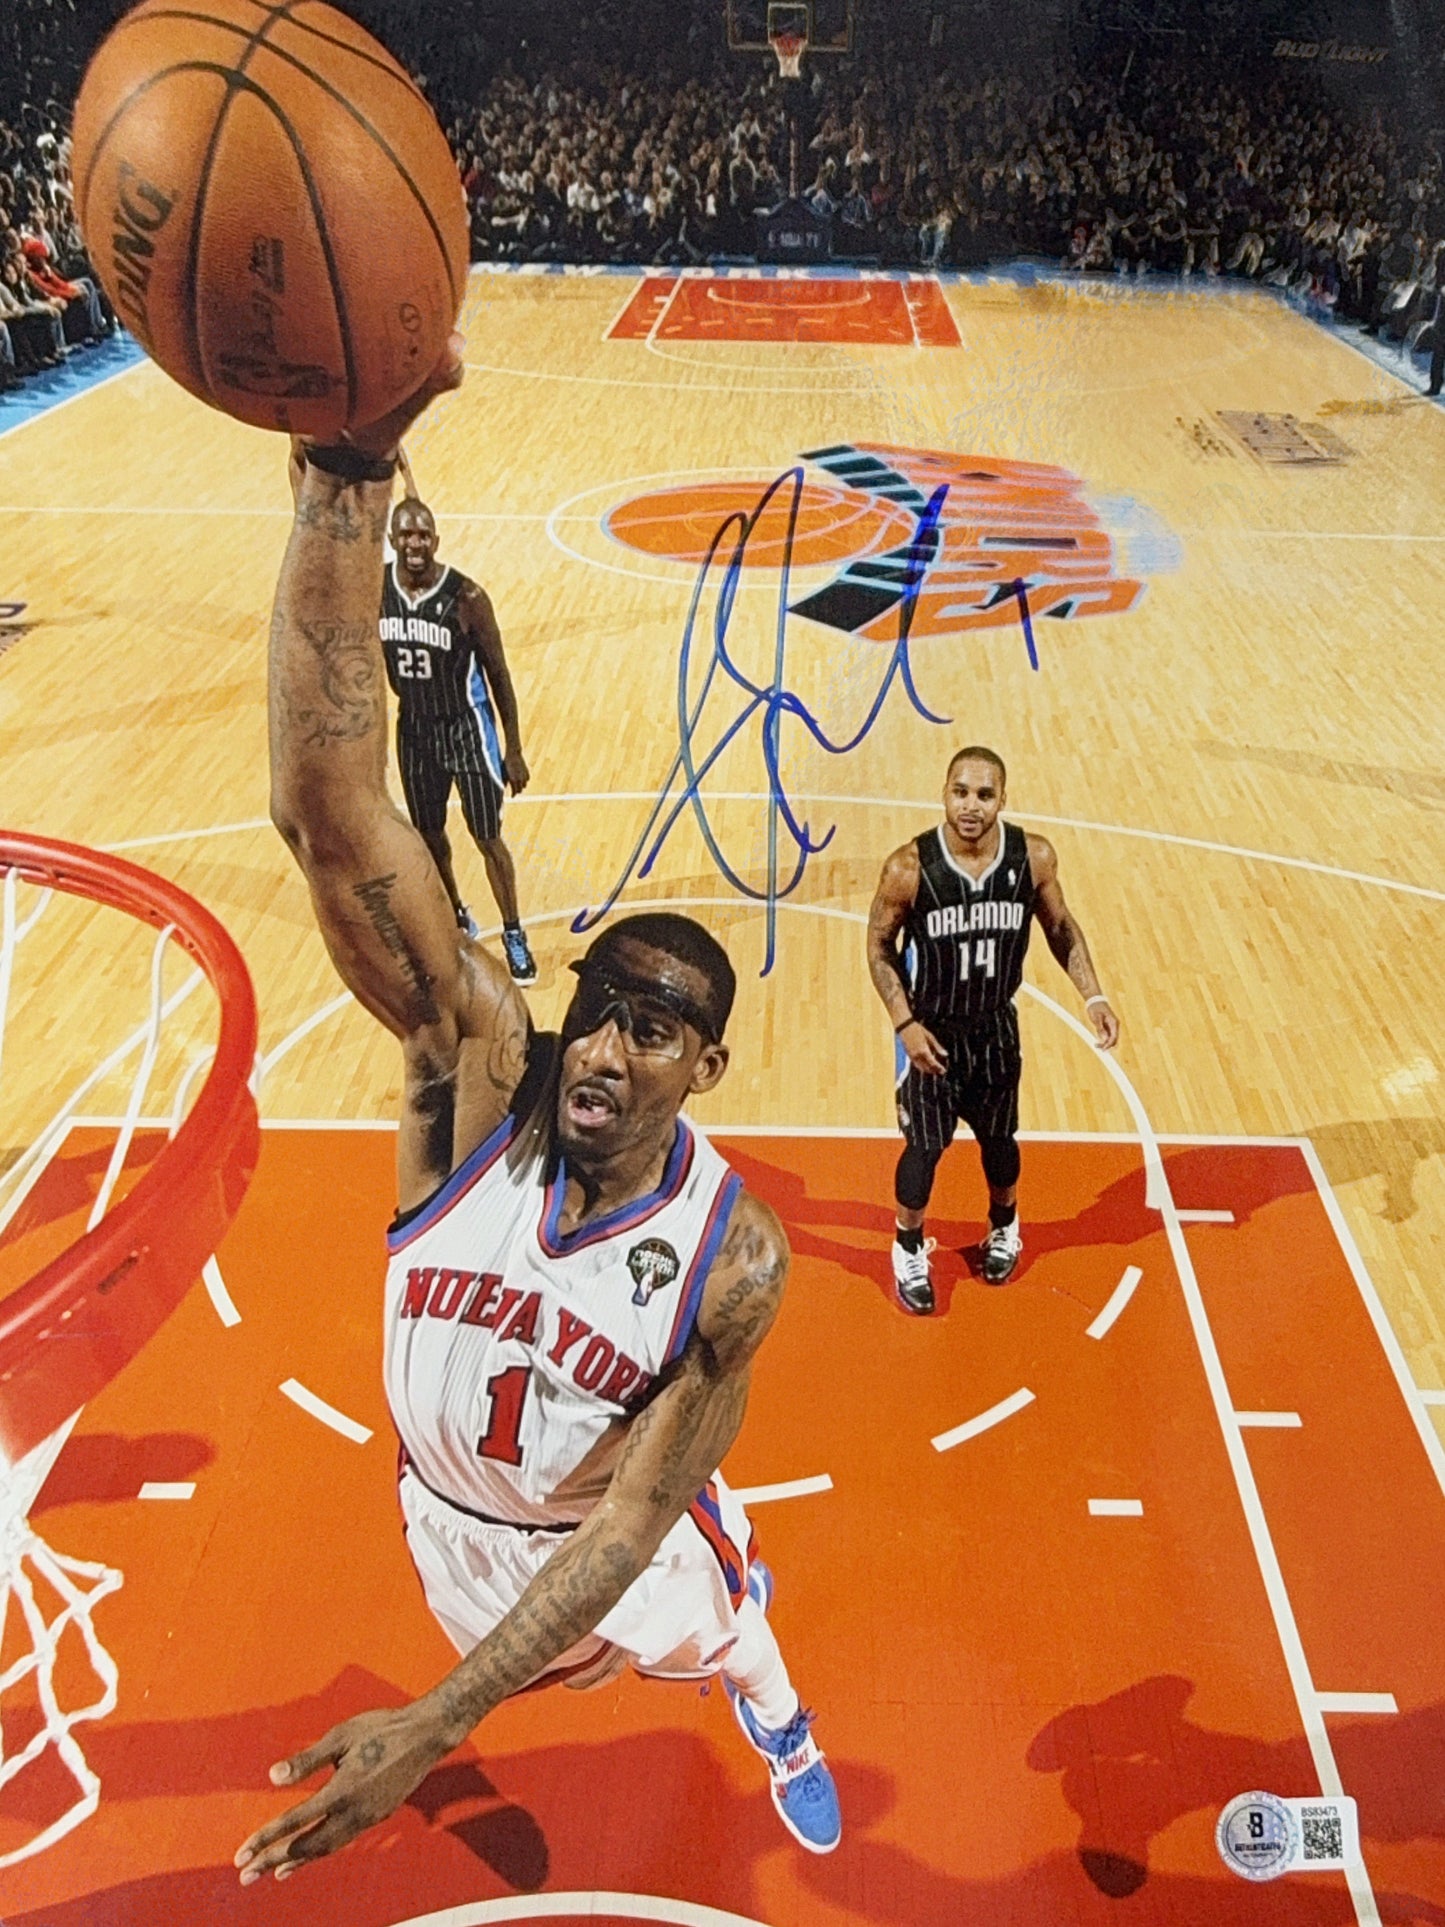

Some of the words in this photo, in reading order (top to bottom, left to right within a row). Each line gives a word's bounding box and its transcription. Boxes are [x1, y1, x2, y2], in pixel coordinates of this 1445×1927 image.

[379, 616, 452, 652] ORLANDO
[397, 647, 432, 679] 23
[926, 901, 1024, 938] ORLANDO
[958, 938, 996, 981] 14
[476, 1366, 533, 1467] 1
